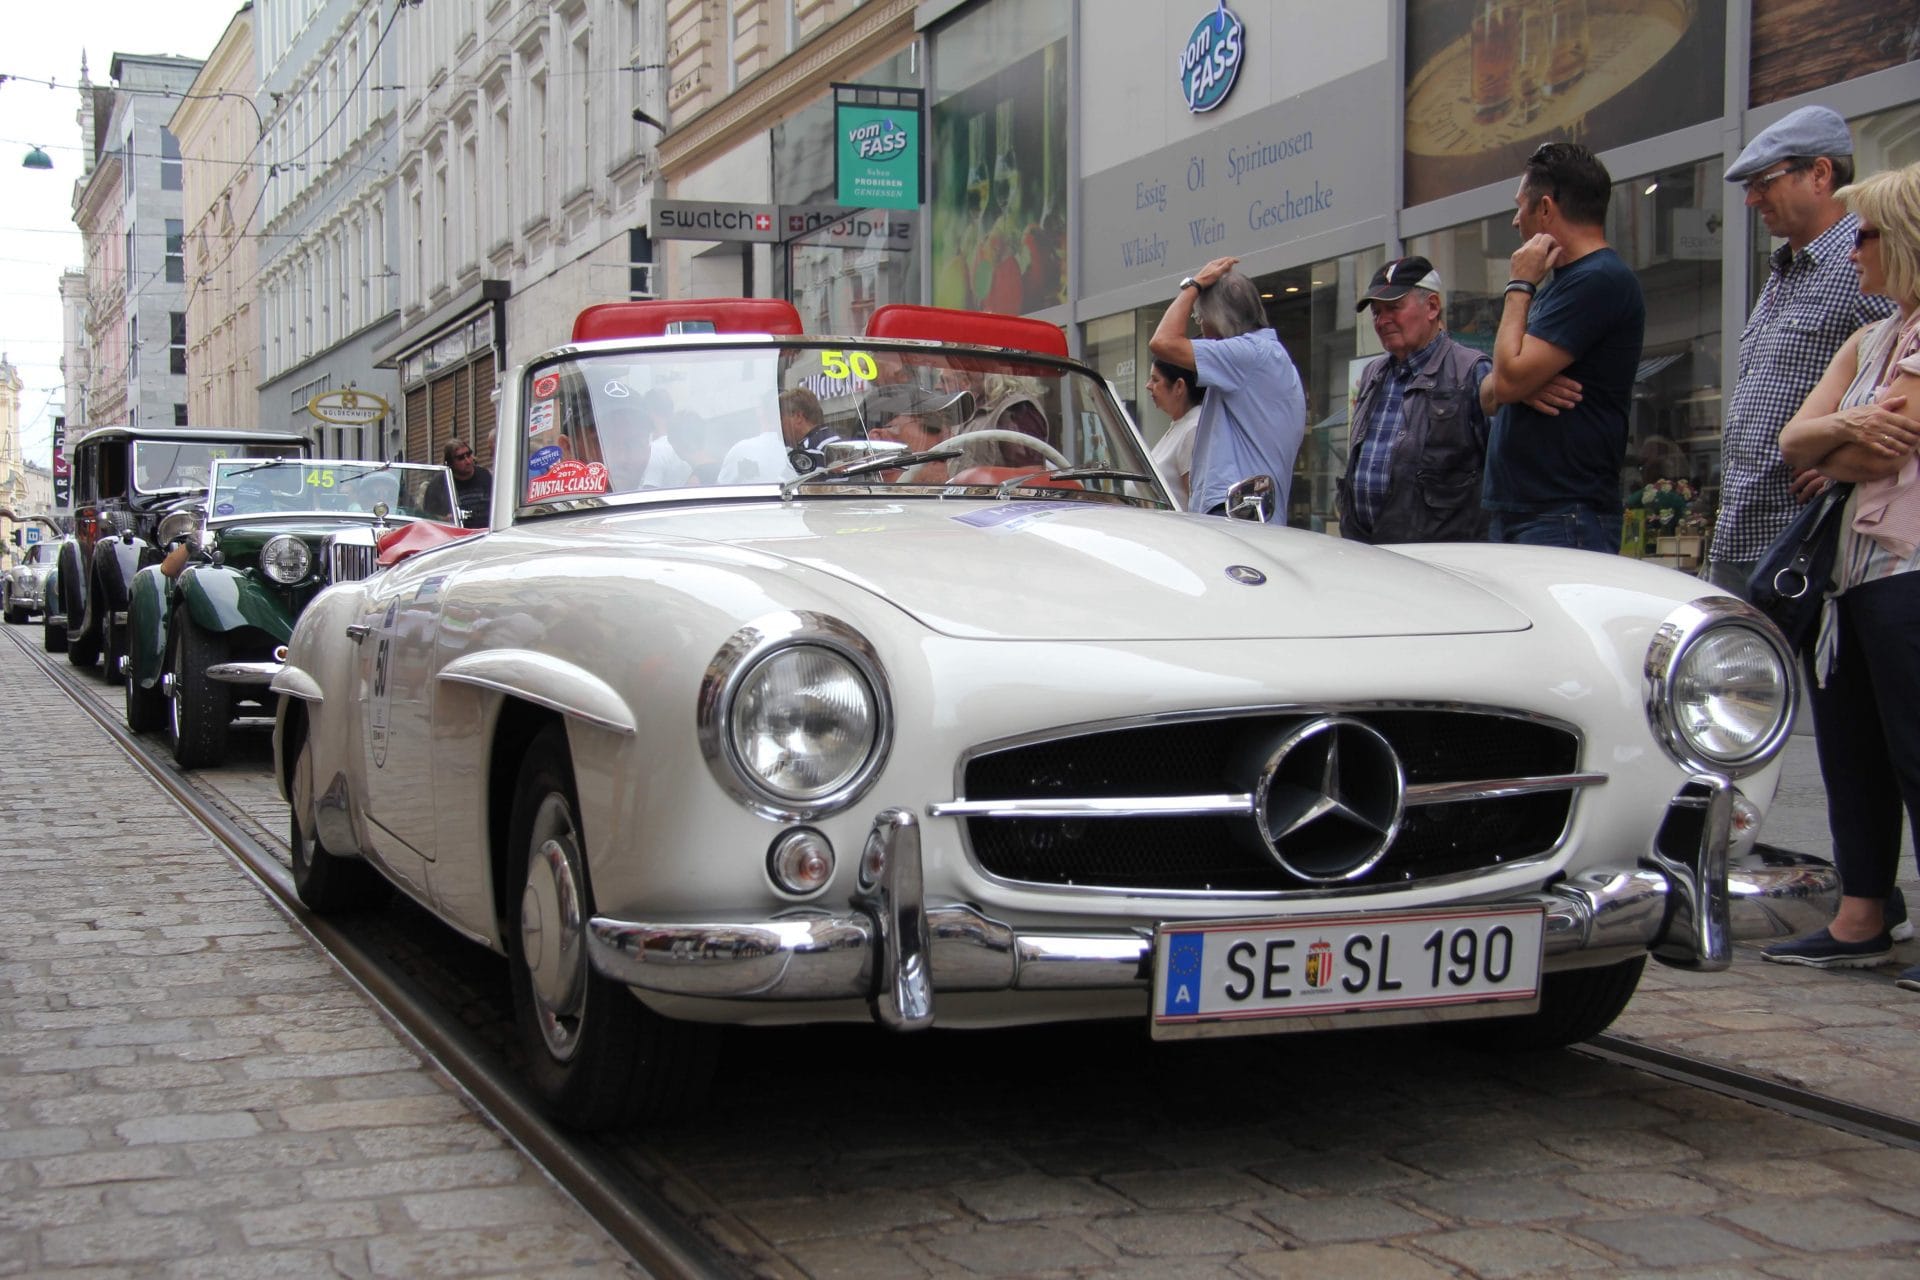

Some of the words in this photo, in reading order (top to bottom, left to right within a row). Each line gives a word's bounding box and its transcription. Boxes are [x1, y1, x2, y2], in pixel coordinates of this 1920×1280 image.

[1179, 25, 1211, 79] vom
[1190, 25, 1238, 108] FASS
[849, 123, 880, 143] vom
[859, 131, 906, 158] FASS
[854, 177, 903, 187] PROBIEREN
[1135, 179, 1167, 212] Essig
[1187, 156, 1205, 192] Öl
[1227, 130, 1314, 185] Spirituosen
[854, 188, 903, 198] GENIESSEN
[660, 208, 753, 231] swatch
[1121, 232, 1169, 268] Whisky
[1188, 217, 1225, 247] Wein
[1248, 180, 1334, 231] Geschenke
[821, 351, 878, 380] 50
[306, 469, 335, 488] 45
[558, 470, 577, 478] 2017
[530, 475, 604, 499] ENNSTAL-CLASSIC
[1224, 939, 1296, 1002] SE
[1341, 933, 1403, 995] SL
[1423, 925, 1513, 989] 190
[1174, 984, 1191, 1004] A
